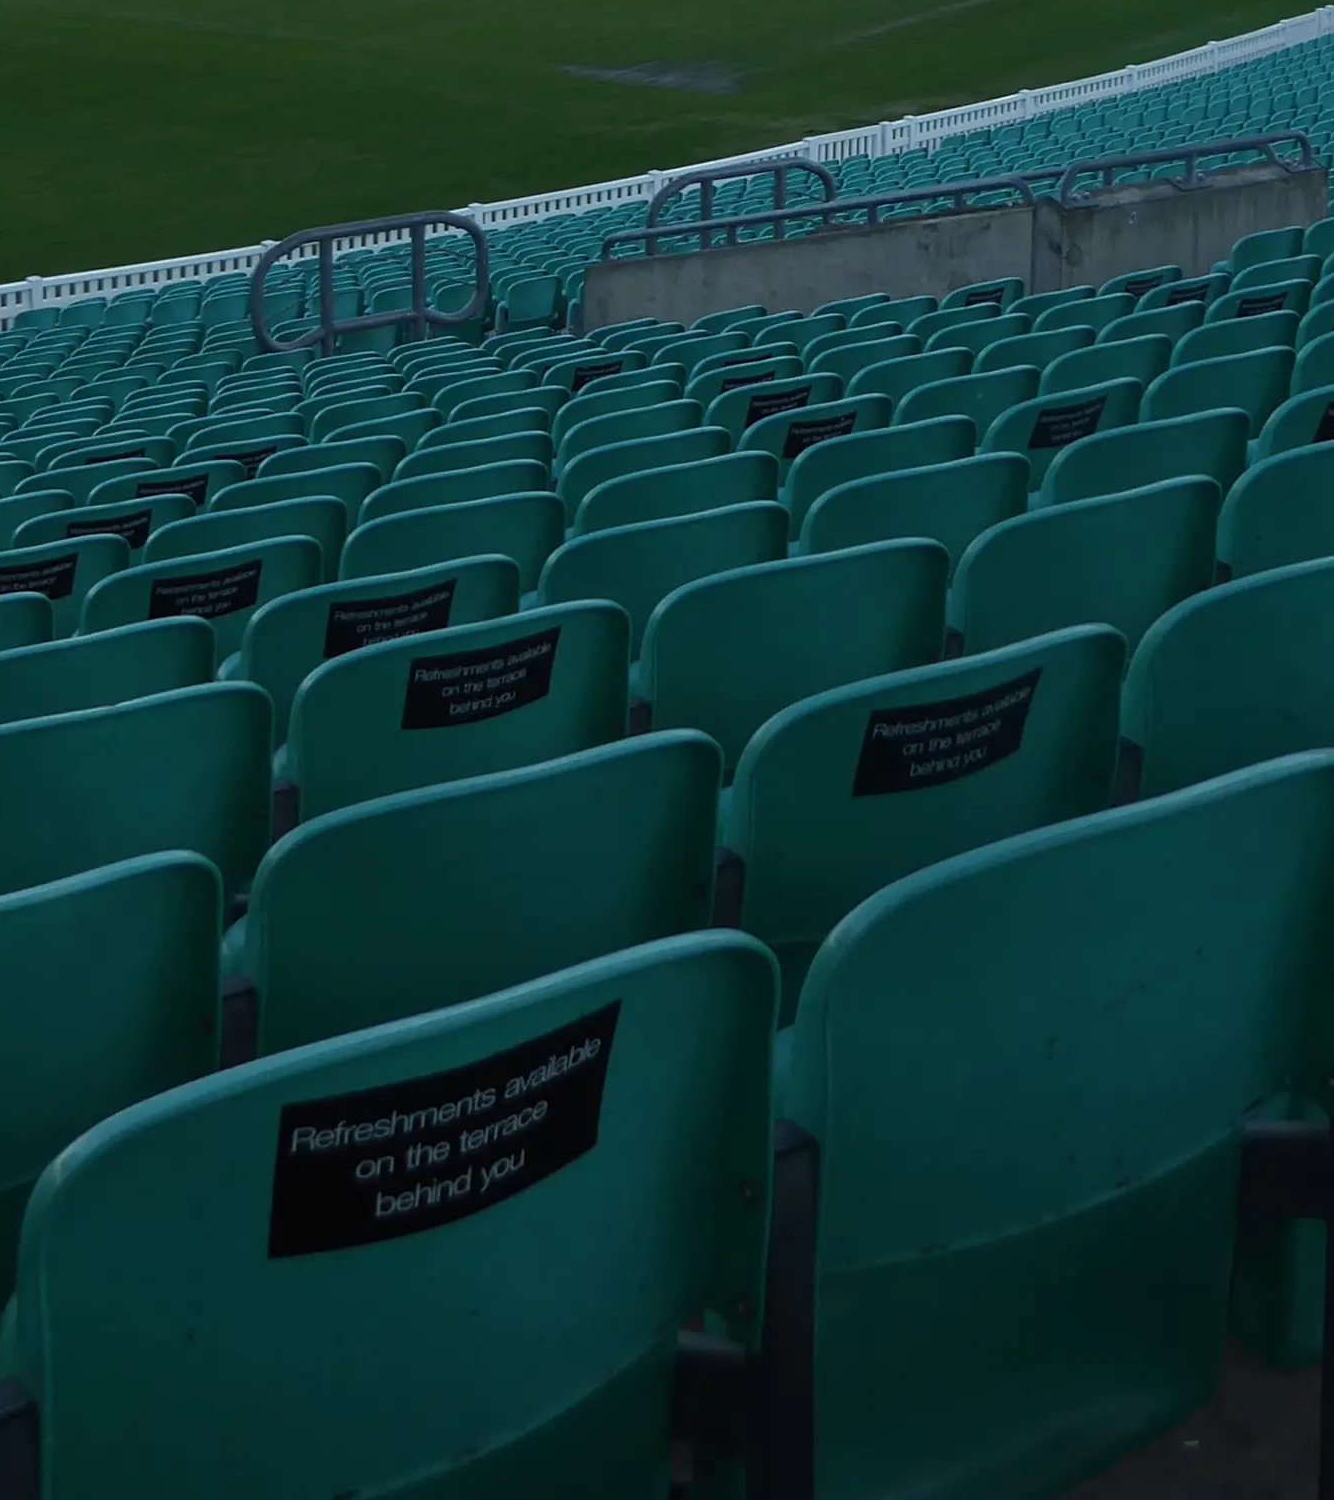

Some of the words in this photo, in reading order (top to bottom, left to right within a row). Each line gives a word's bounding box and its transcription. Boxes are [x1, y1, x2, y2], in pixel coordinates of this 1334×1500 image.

[415, 658, 505, 683] Refreshments
[441, 685, 460, 698] on
[463, 680, 484, 694] the
[487, 668, 527, 689] terrace
[449, 694, 493, 716] behind
[495, 690, 516, 708] you
[872, 708, 980, 740] Refreshments
[902, 741, 923, 756] on
[928, 736, 953, 752] the
[955, 718, 1001, 746] terrace
[909, 754, 962, 778] behind
[963, 747, 988, 768] you
[290, 1086, 496, 1155] Refreshments
[504, 1037, 602, 1100] available
[355, 1155, 395, 1180] on
[406, 1140, 450, 1170] the
[459, 1100, 549, 1154] terrace
[375, 1166, 473, 1218] behind
[479, 1148, 527, 1193] you
